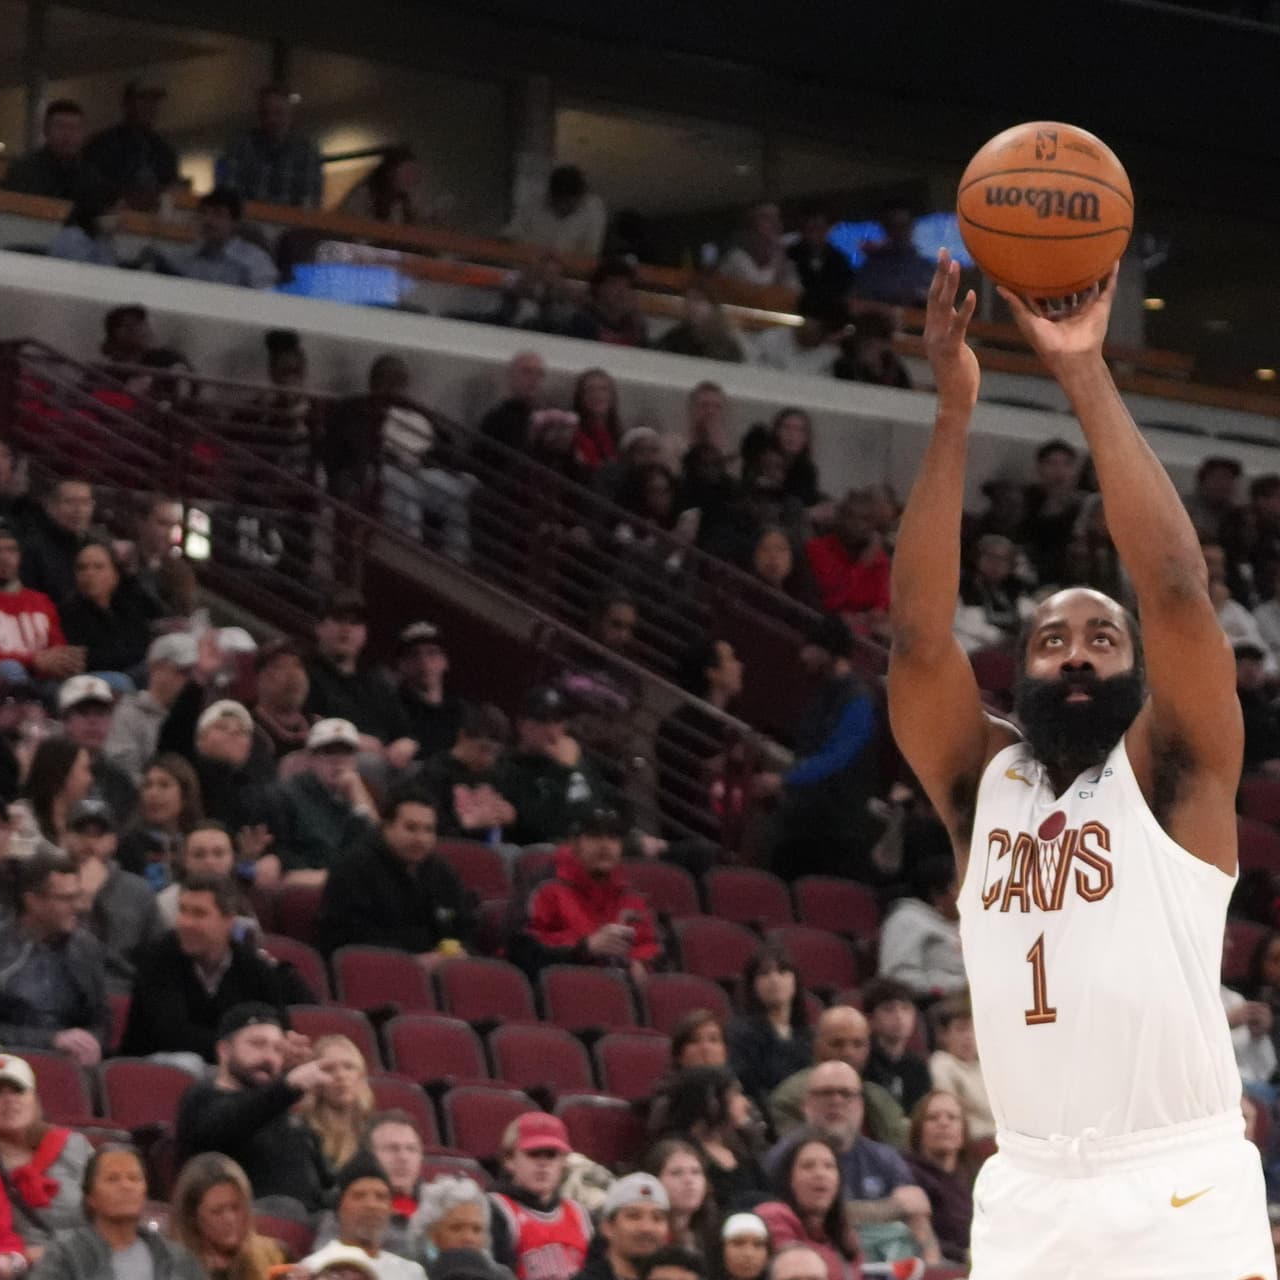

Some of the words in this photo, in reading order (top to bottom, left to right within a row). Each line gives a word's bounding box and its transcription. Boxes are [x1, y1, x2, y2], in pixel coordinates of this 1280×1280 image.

[986, 187, 1100, 222] Wilson
[981, 820, 1114, 913] CAVS
[1024, 930, 1057, 1026] 1
